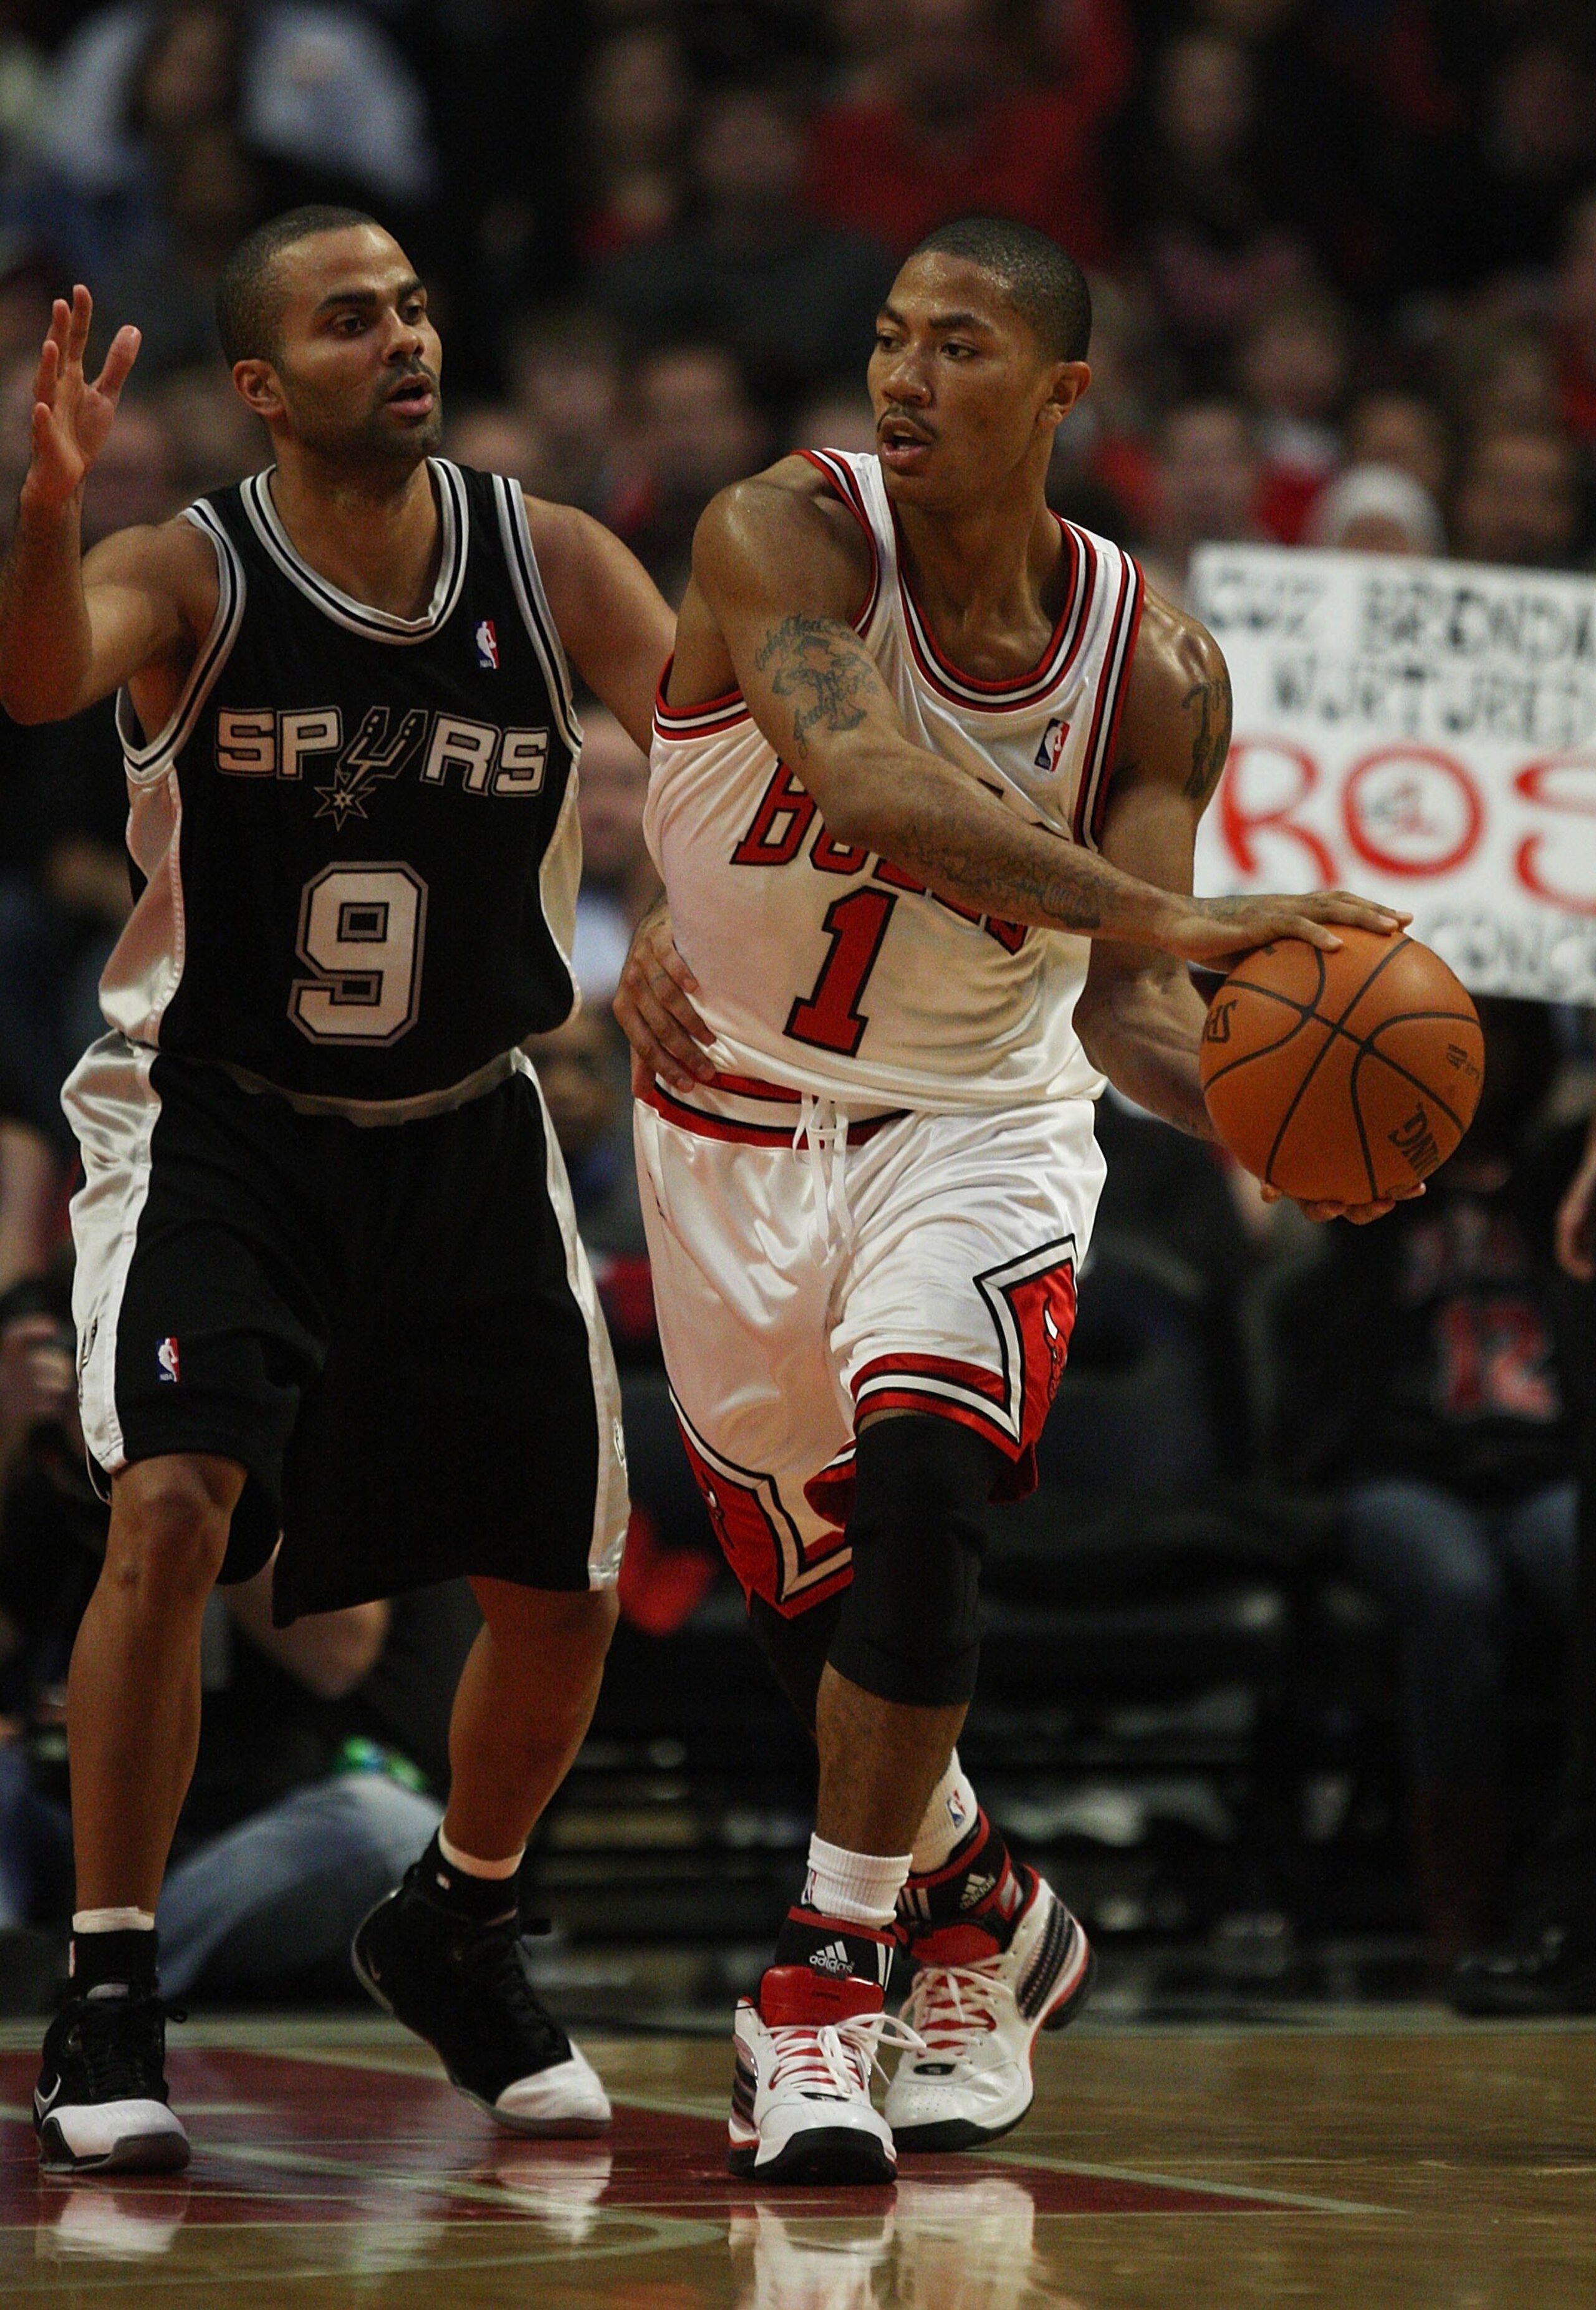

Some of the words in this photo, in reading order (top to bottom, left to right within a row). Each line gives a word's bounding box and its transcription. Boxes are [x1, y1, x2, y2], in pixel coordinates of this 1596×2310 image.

[216, 706, 549, 798] SPURS
[287, 861, 429, 1047] 9
[782, 885, 899, 1058] 1
